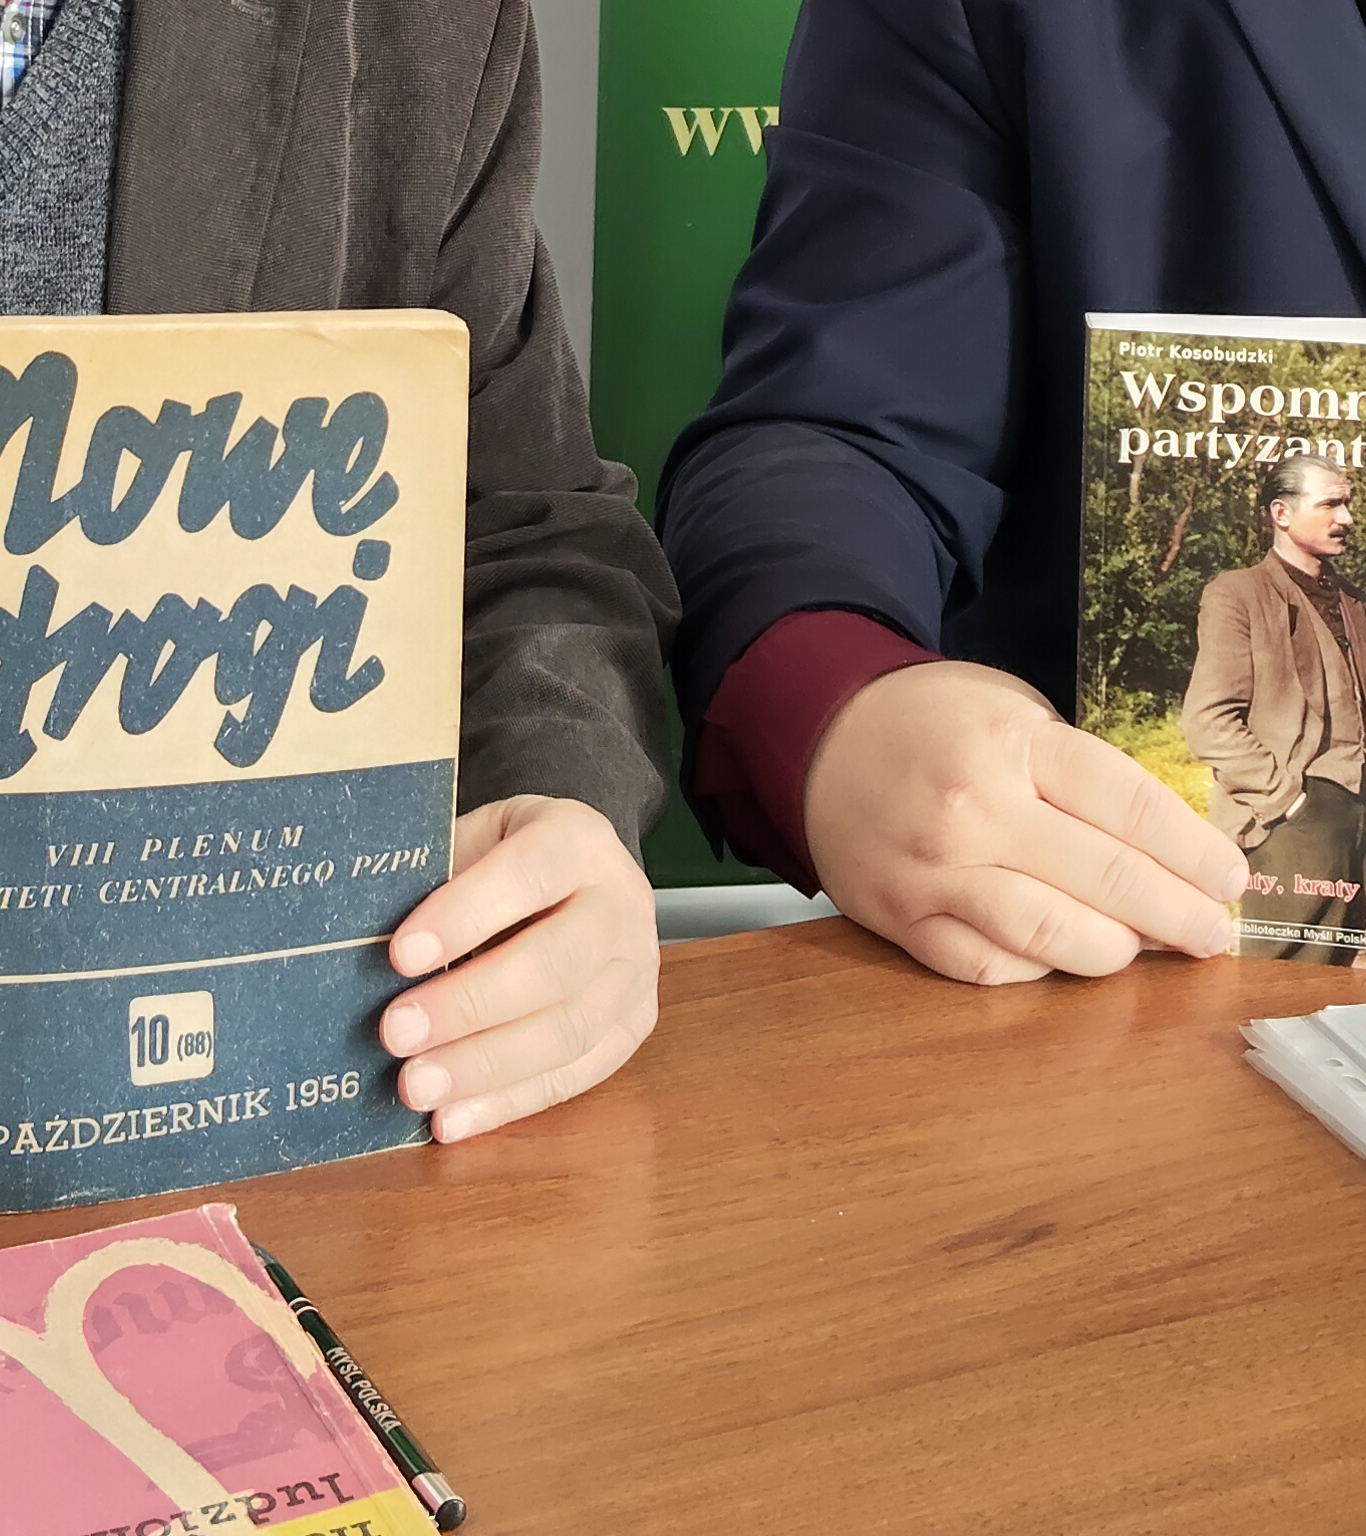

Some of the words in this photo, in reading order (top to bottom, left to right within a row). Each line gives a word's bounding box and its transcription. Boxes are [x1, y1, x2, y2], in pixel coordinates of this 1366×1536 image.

[1118, 341, 1164, 359] Piotr
[1168, 344, 1274, 365] Kosobudzki
[46, 841, 115, 868] VIII
[141, 825, 305, 863] PLENUM
[98, 860, 335, 905] CENTRALNEGO
[351, 846, 433, 878] PZPR
[1292, 873, 1361, 903] kraty
[131, 1014, 171, 1069] 10
[176, 1031, 213, 1061] (88)
[285, 1071, 361, 1112] 1956
[351, 1379, 402, 1434] POLSKA
